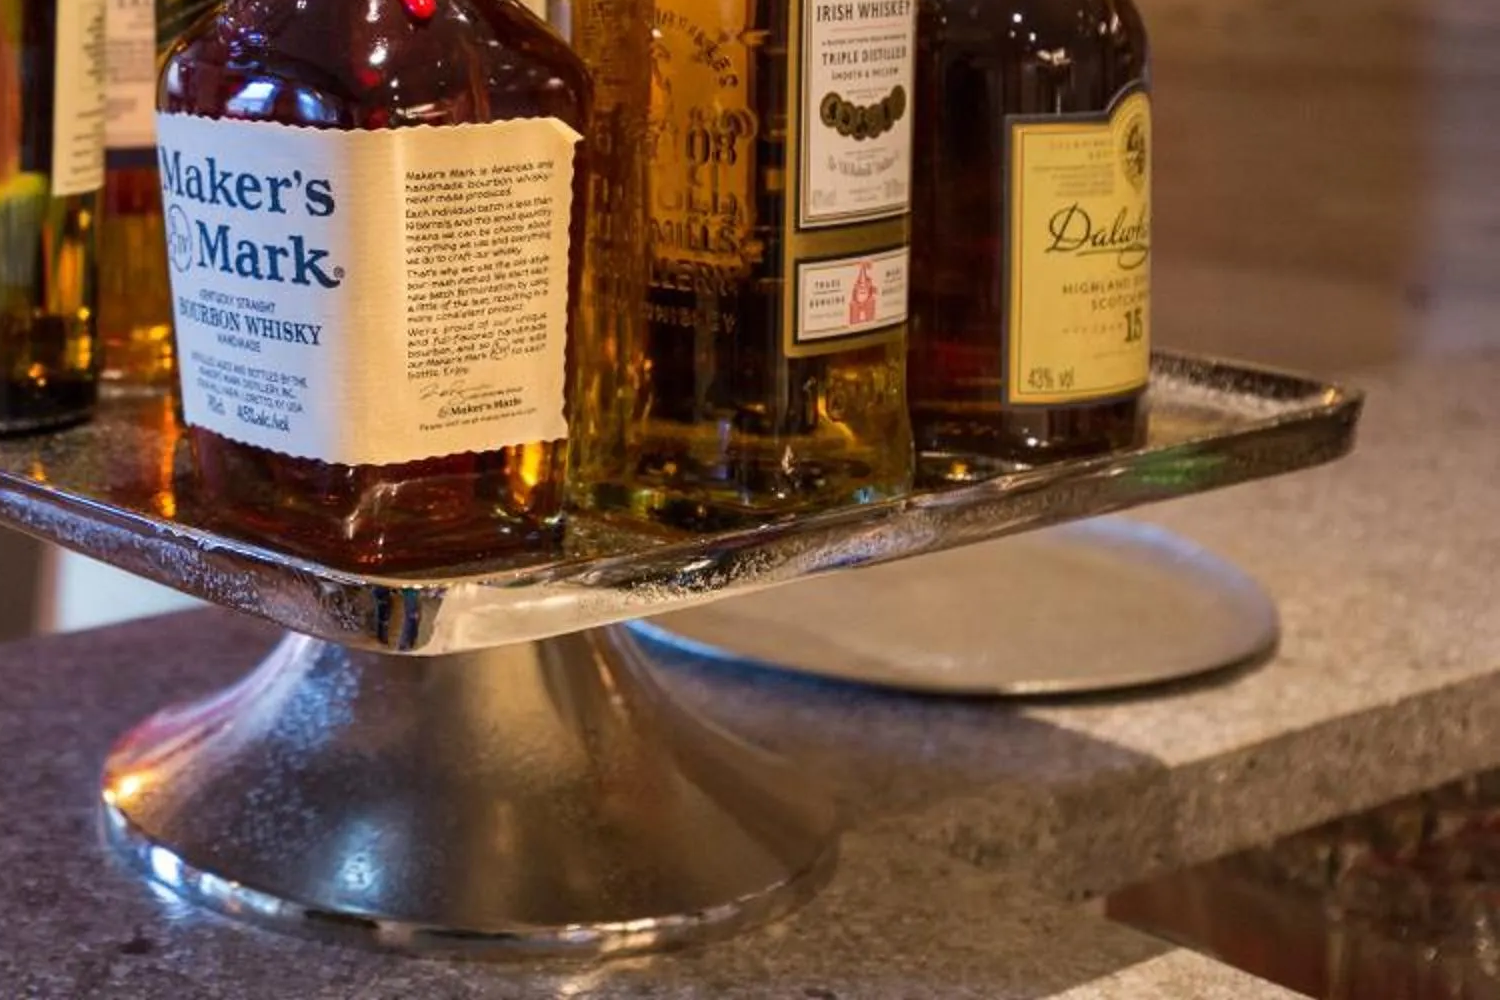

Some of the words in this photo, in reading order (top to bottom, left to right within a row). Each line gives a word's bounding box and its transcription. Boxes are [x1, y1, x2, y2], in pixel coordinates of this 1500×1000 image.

[816, 3, 853, 22] IRISH
[857, 0, 911, 19] WHISKEY
[821, 50, 858, 66] TRIPLE
[160, 146, 336, 217] Maker's
[450, 169, 475, 178] Mark
[406, 182, 463, 192] handmade
[468, 177, 513, 188] bourbon
[1062, 278, 1131, 296] HIGHLAND
[244, 315, 322, 345] WHISKY
[1124, 308, 1143, 342] 15
[1028, 368, 1054, 389] 43%
